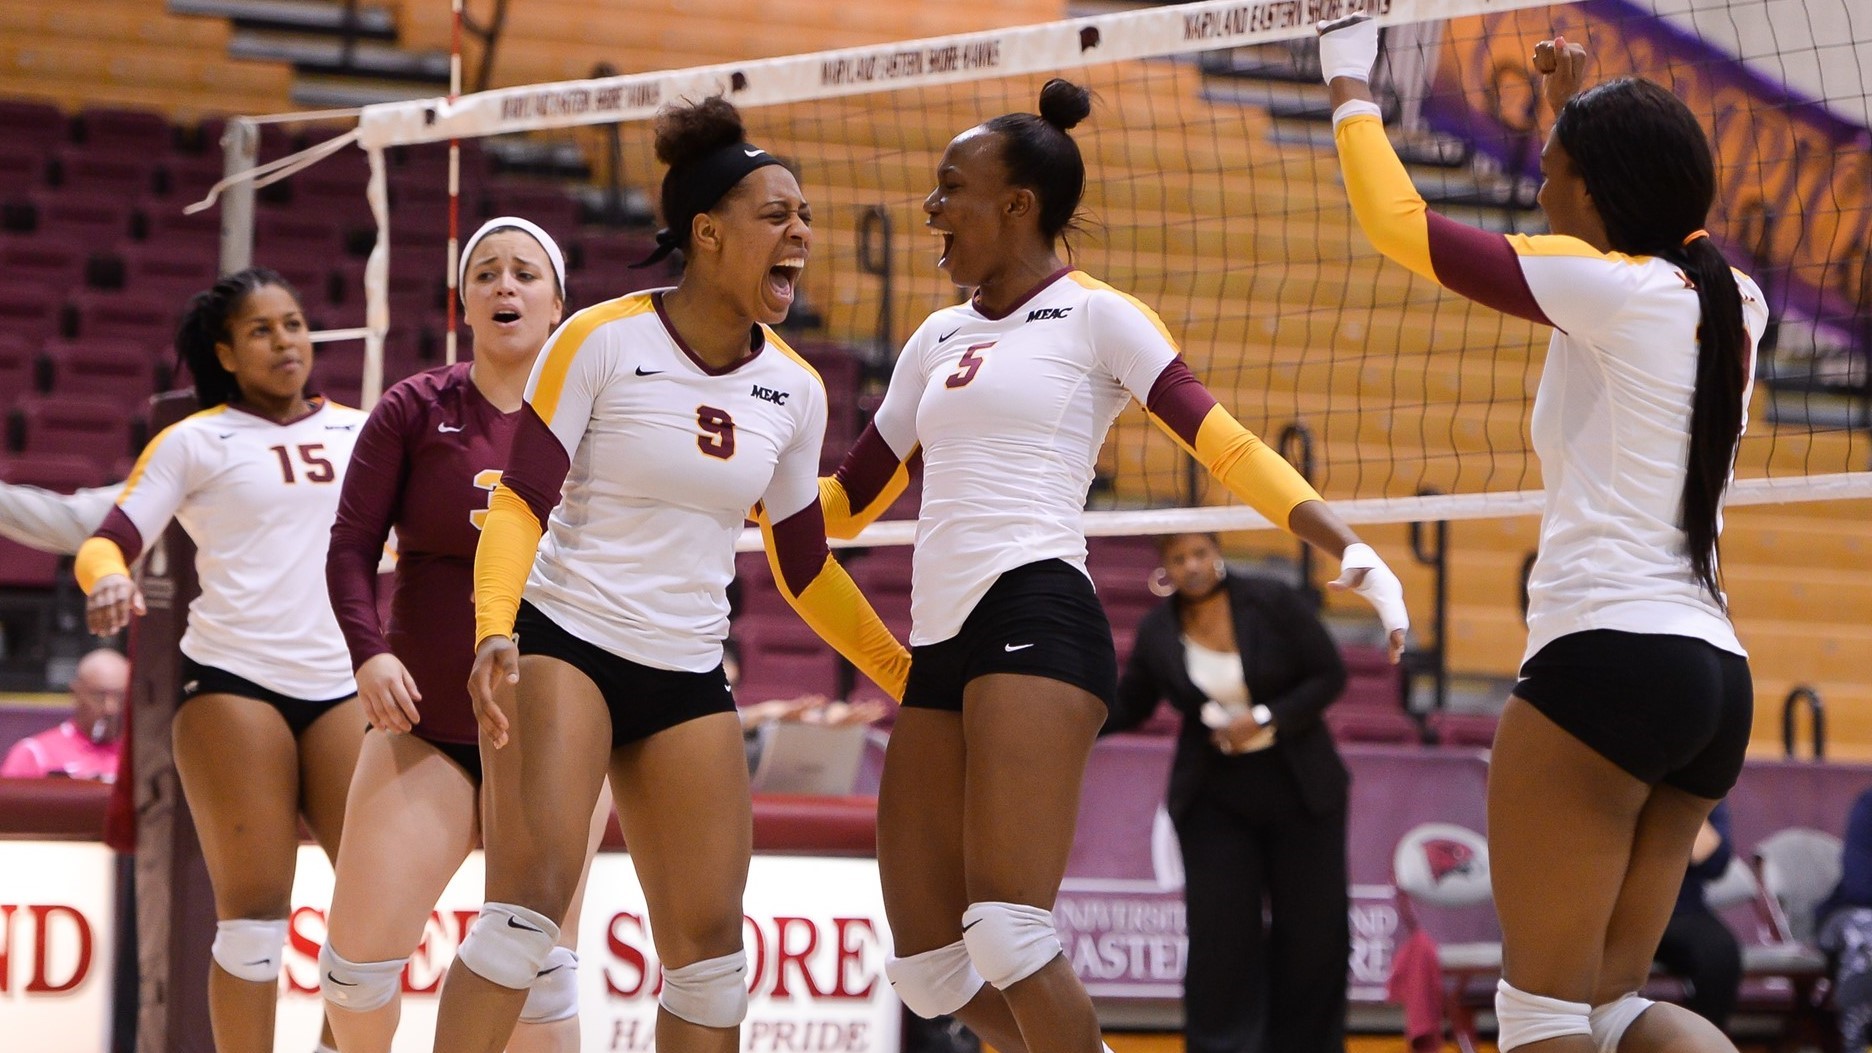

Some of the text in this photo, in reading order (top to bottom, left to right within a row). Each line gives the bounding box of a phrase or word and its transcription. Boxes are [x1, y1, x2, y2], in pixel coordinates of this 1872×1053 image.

[1025, 306, 1073, 323] MEAC
[944, 340, 999, 390] 5
[750, 384, 790, 407] MEAC
[696, 404, 736, 461] 9
[269, 443, 336, 484] 15
[749, 1021, 868, 1051] PRIDE
